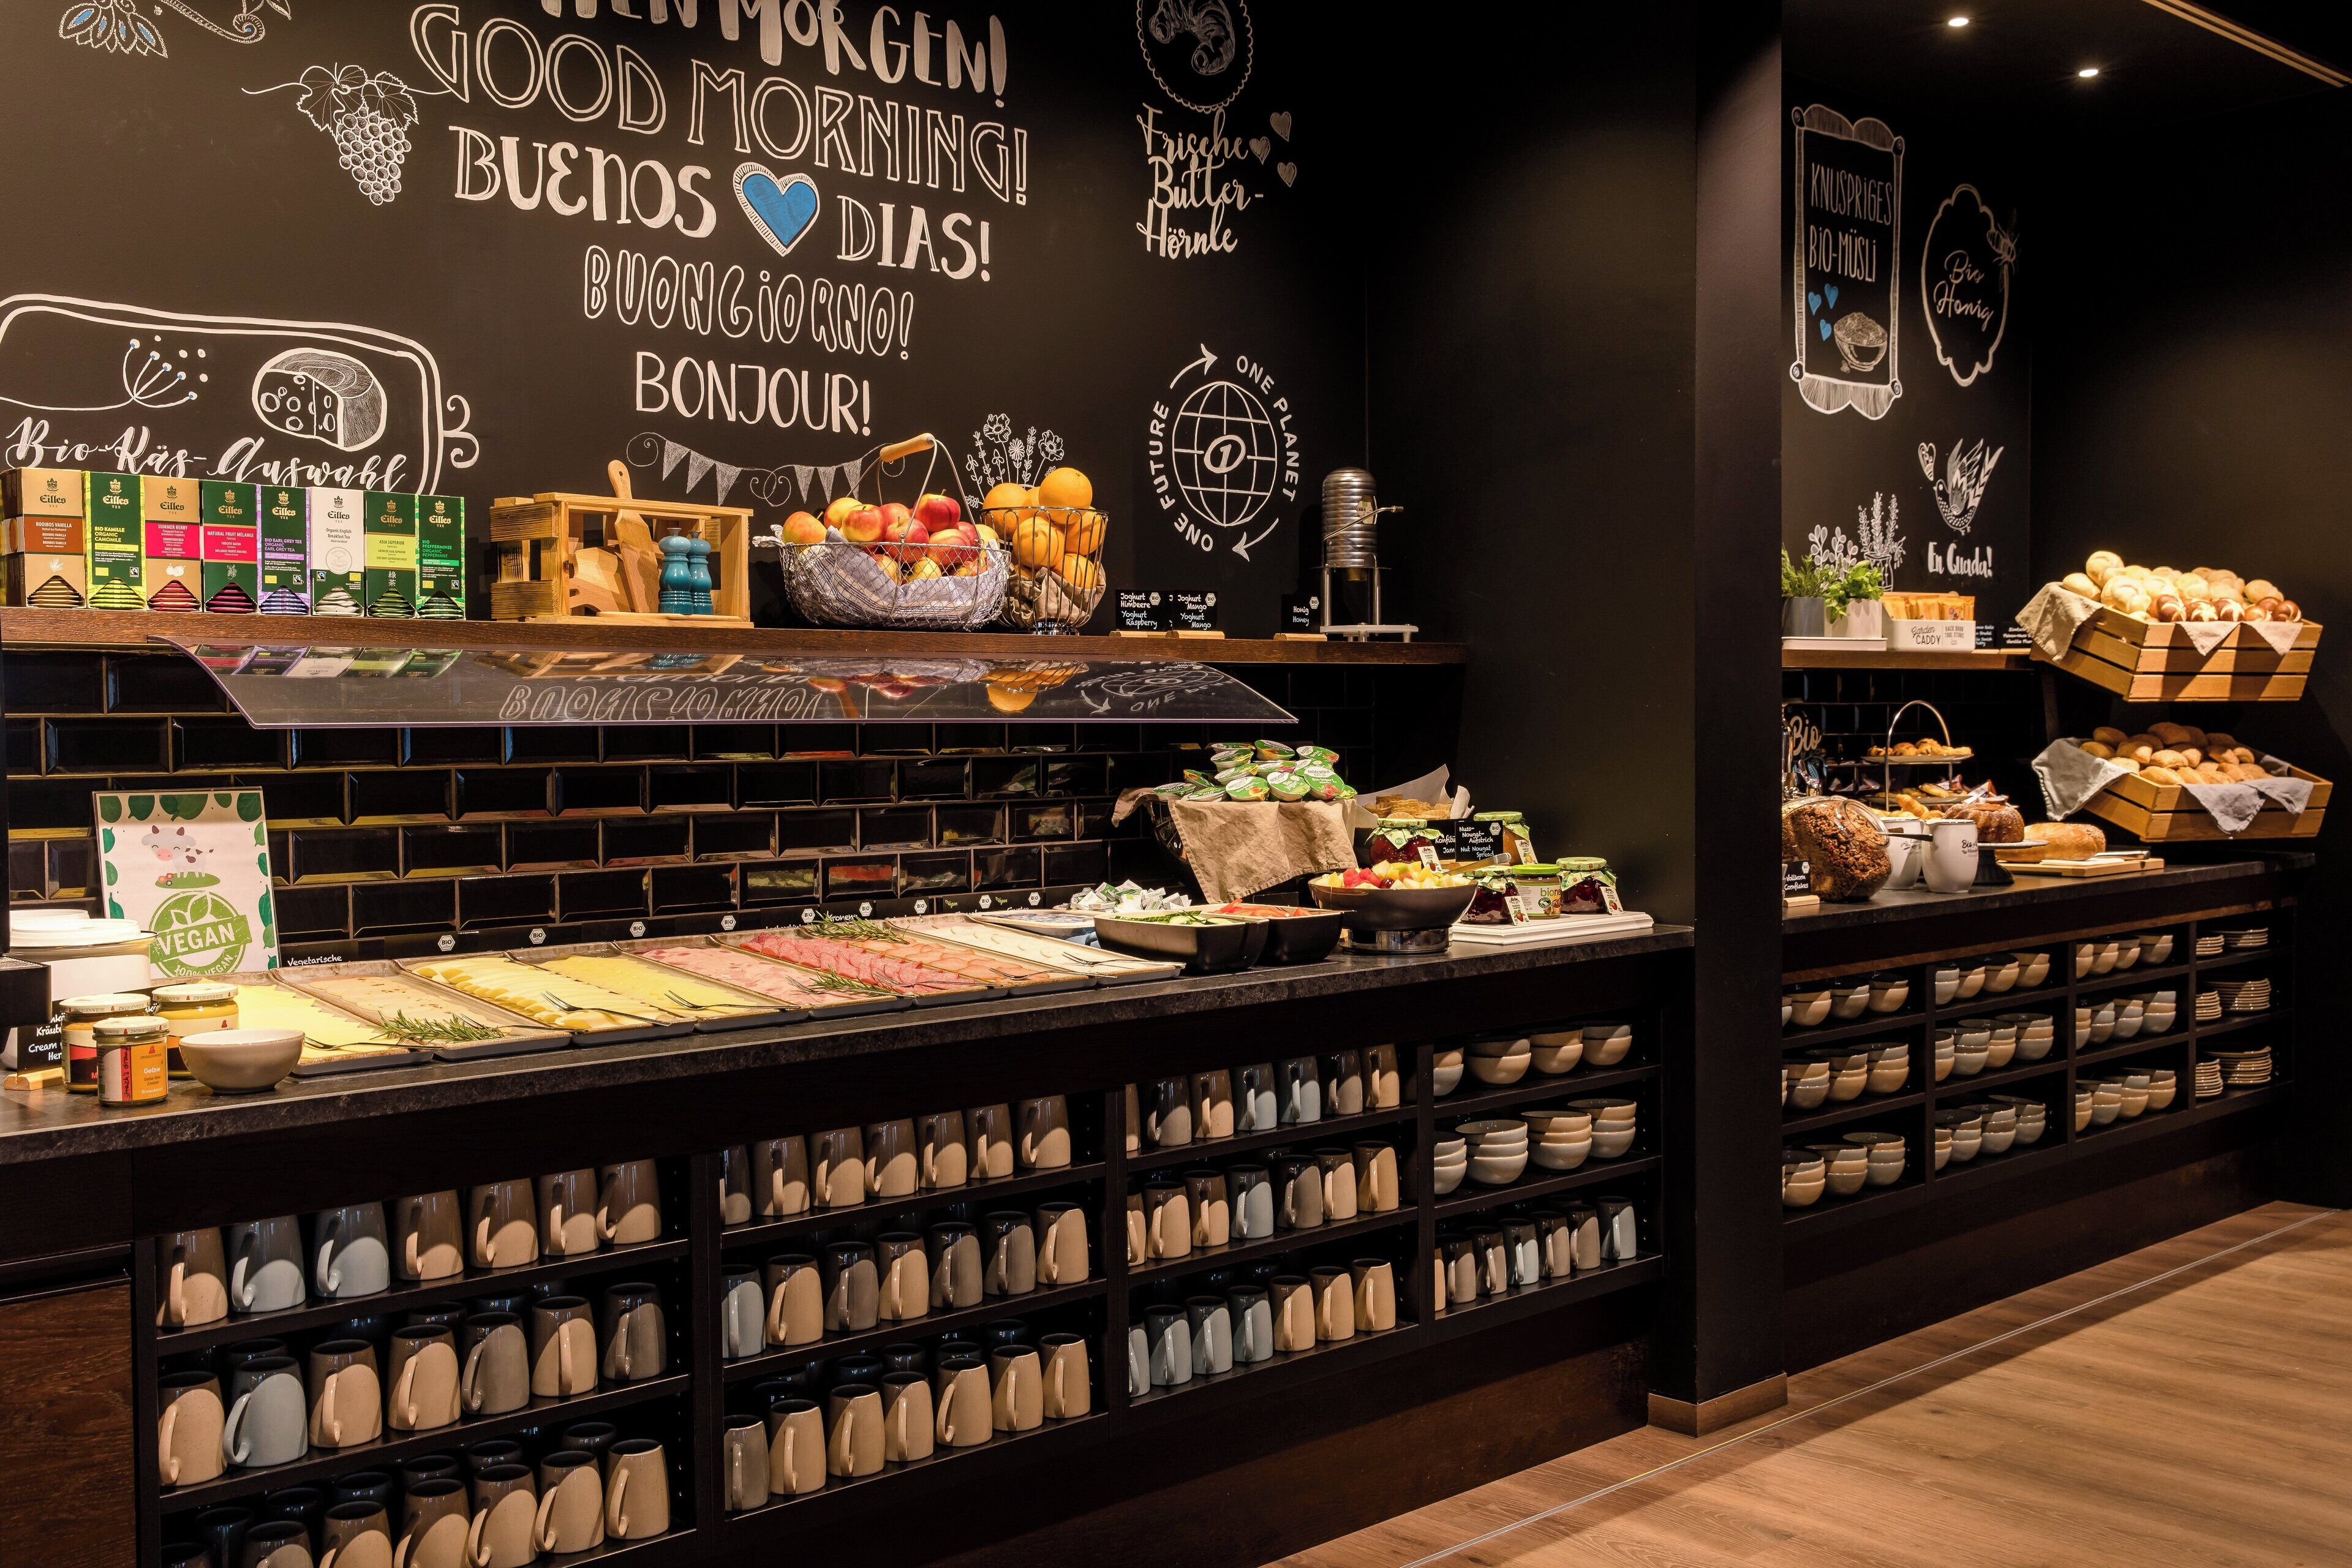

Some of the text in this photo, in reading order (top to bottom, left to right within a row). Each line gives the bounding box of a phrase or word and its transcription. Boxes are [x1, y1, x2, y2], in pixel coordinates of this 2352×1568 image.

[410, 4, 1027, 205] GOOD MORNING!
[1137, 103, 1249, 164] Frische
[1148, 155, 1264, 211] Butter-
[449, 126, 990, 282] BUENOS DIAS!
[1137, 198, 1238, 259] Hörnle
[1944, 251, 1985, 284] Bio
[1934, 281, 1994, 331] Honig
[635, 351, 870, 436] BONJOUR!
[1237, 356, 1300, 502] ONE PLANET
[1149, 400, 1213, 552] ONE FUTURE
[40, 495, 66, 503] Eilles
[102, 495, 129, 505] Eilles
[160, 502, 184, 510] Eilles
[218, 505, 243, 514] Eilles
[272, 507, 296, 516] Eilles
[328, 511, 350, 519] Eilles
[380, 515, 402, 524] Eilles
[429, 515, 451, 524] Eilles
[1120, 592, 1145, 602] Joghurt
[1177, 594, 1201, 604] Joghurt
[1187, 603, 1207, 612] Mango
[1294, 606, 1309, 616] Honig
[1121, 610, 1147, 620] Yoghurt
[1180, 612, 1205, 622] Yoghurt
[1126, 619, 1158, 630] Raspberry
[1191, 622, 1212, 630] Mango
[1293, 616, 1310, 627] Honey
[1916, 635, 1942, 645] CADDY
[1435, 835, 1456, 845] Konfitü
[1476, 851, 1494, 860] Spread
[1784, 881, 1809, 891] Cornflakes
[1540, 888, 1561, 897] bione
[157, 922, 236, 956] VEGAN
[287, 954, 342, 967] Vegetarische
[36, 1025, 62, 1037] Kräute
[28, 1042, 57, 1053] Cream
[48, 1051, 62, 1061] Her
